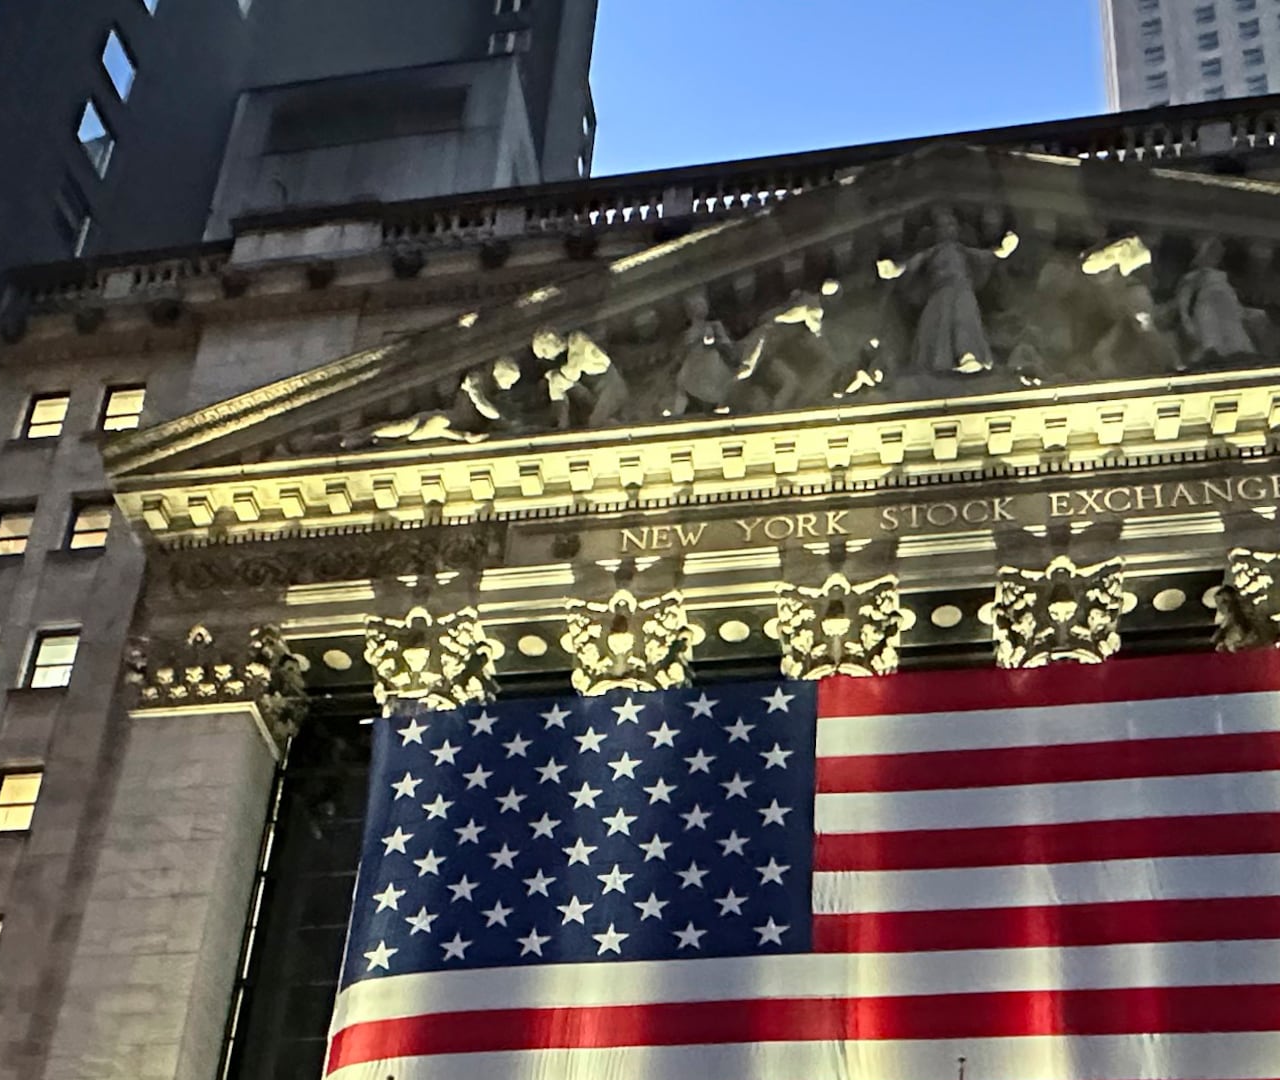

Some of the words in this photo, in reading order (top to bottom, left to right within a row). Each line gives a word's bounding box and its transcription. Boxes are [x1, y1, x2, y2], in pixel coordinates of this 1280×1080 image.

[621, 522, 708, 552] NEW
[736, 510, 850, 542] YORK
[879, 496, 1016, 531] STOCK
